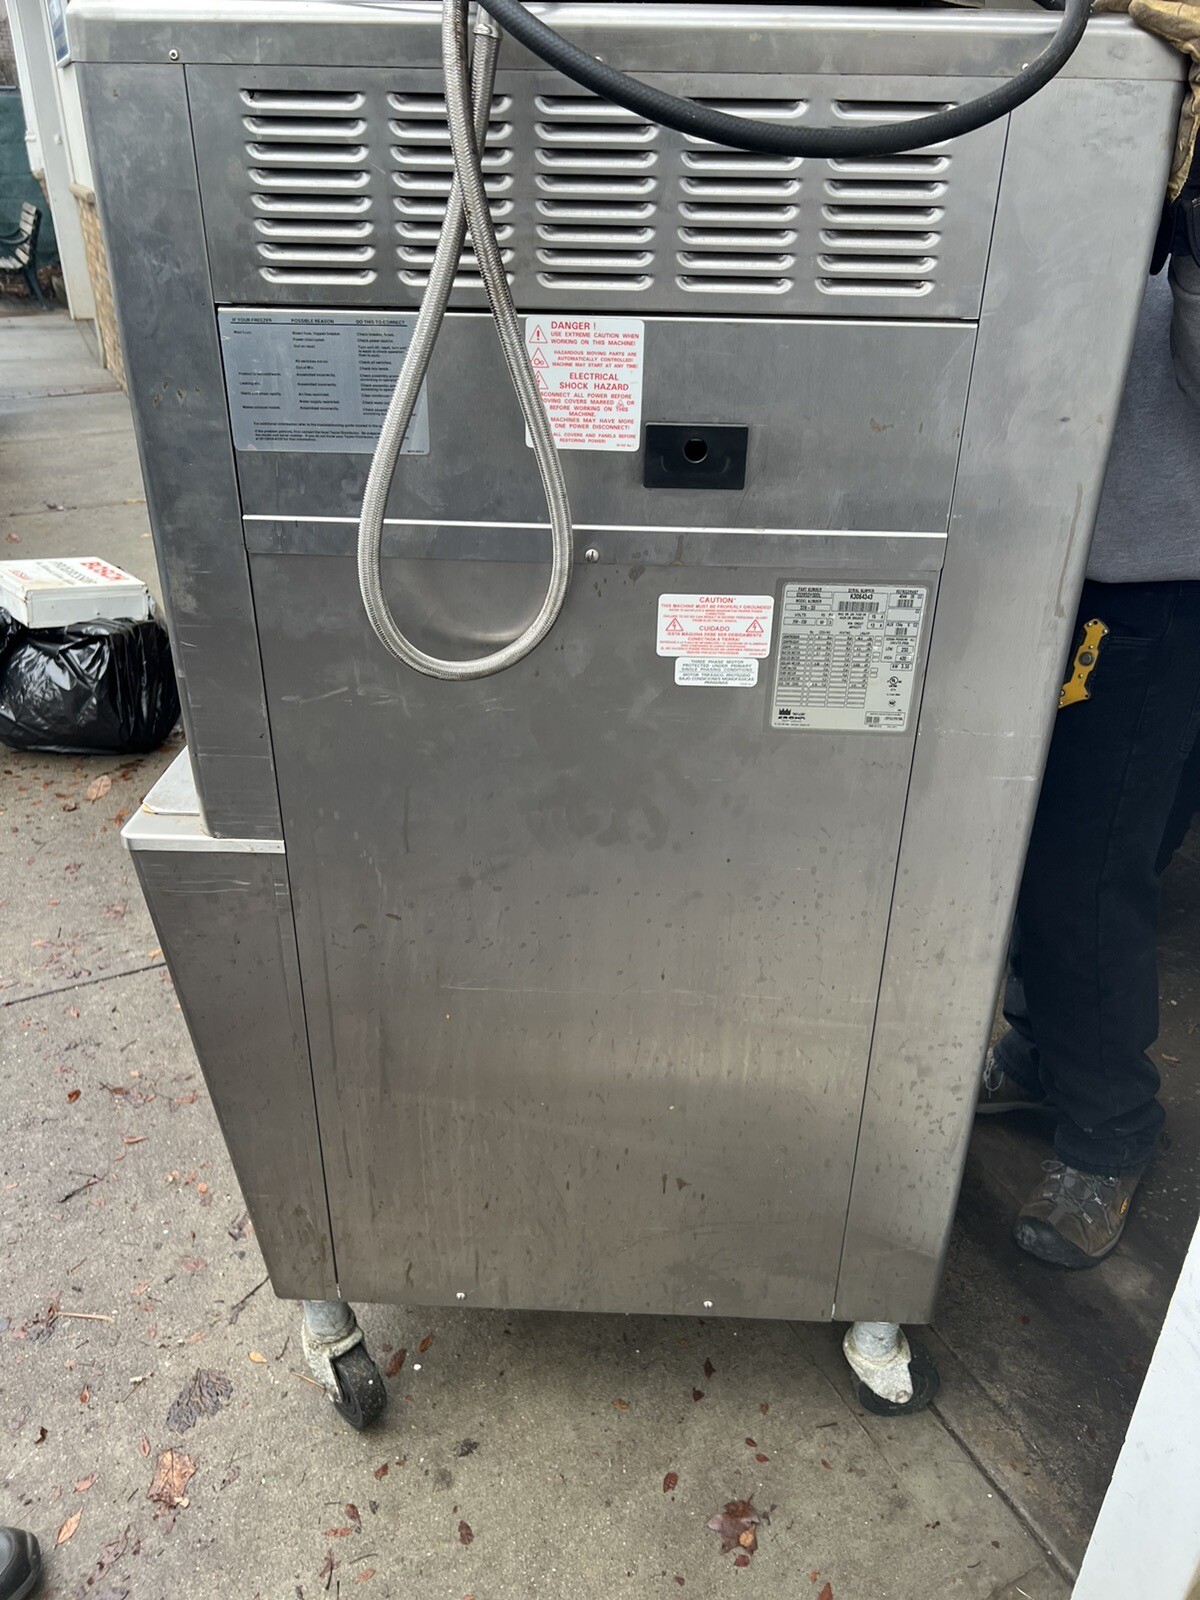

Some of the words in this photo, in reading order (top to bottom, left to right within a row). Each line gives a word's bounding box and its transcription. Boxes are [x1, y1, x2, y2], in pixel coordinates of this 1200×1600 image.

[551, 321, 590, 330] DANGER
[569, 372, 619, 381] ELECTRICAL
[559, 382, 588, 390] SHOCK
[594, 383, 629, 391] HAZARD
